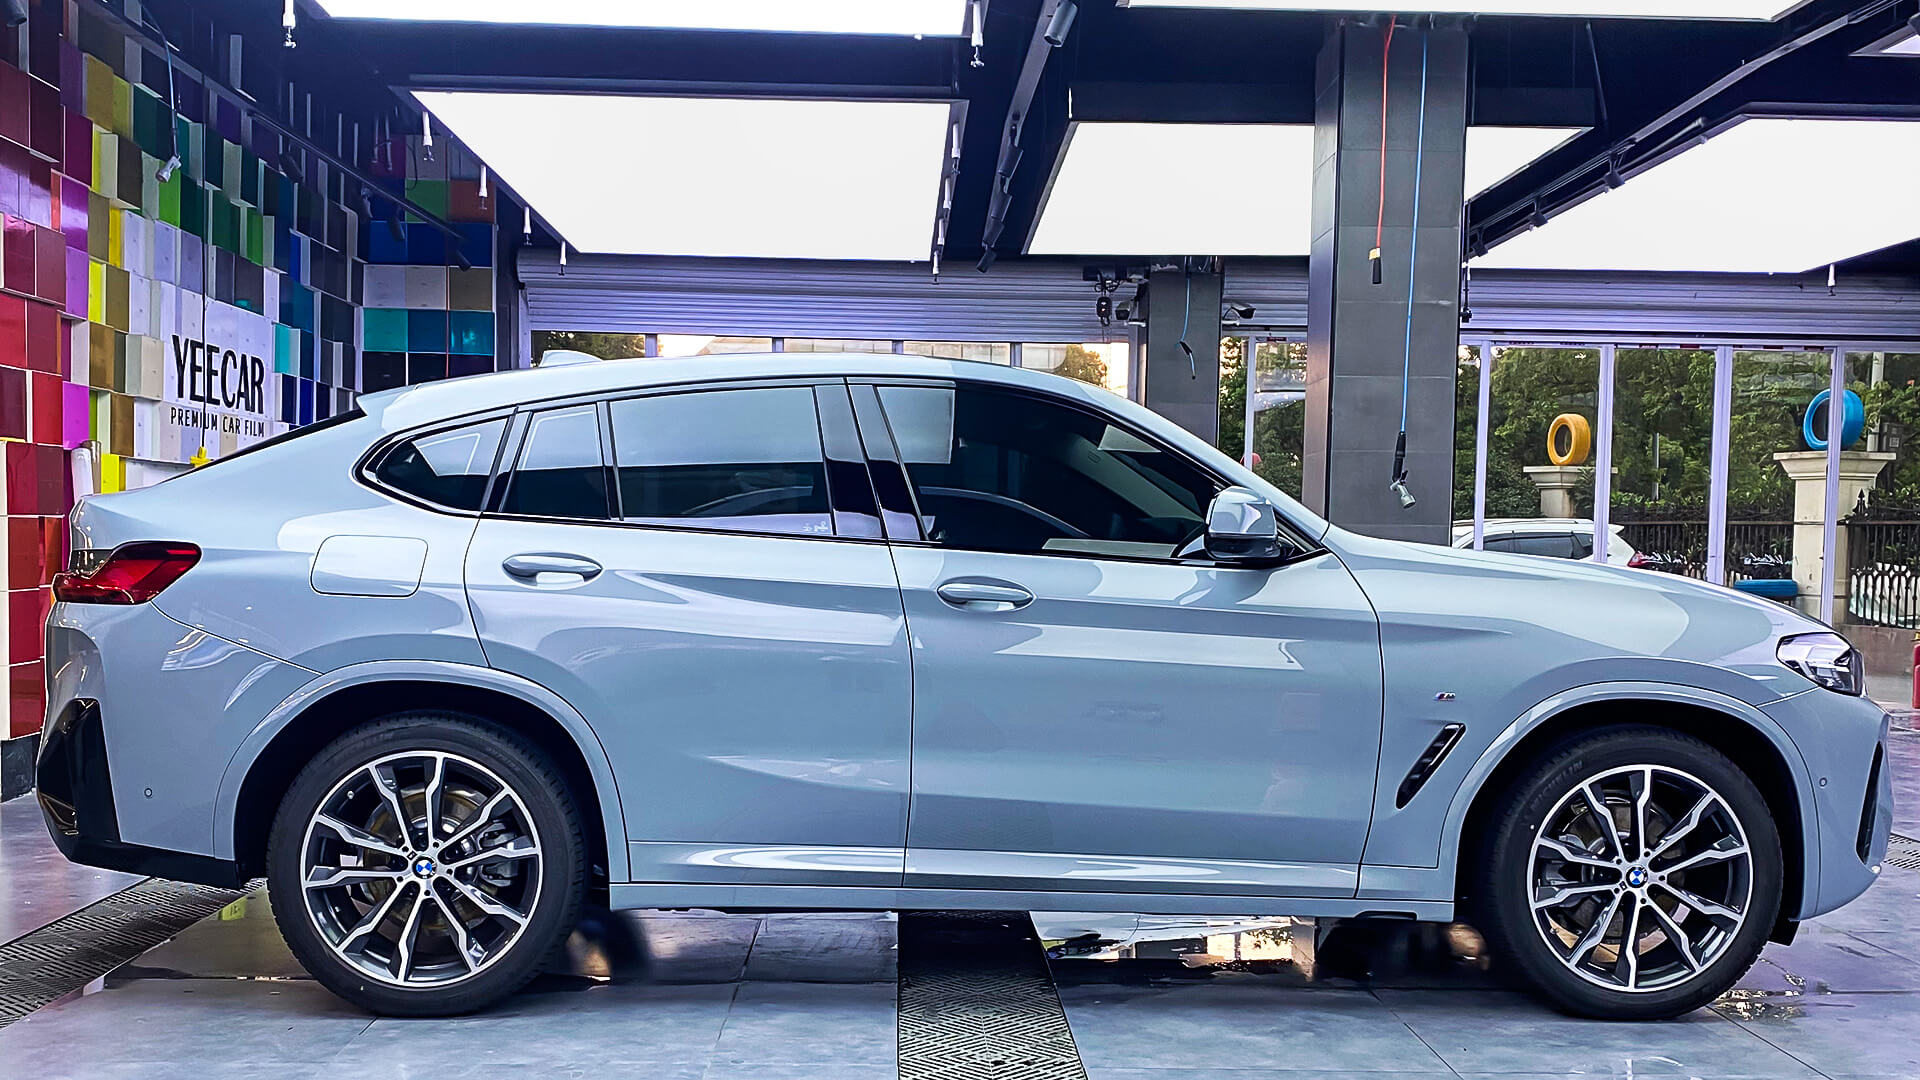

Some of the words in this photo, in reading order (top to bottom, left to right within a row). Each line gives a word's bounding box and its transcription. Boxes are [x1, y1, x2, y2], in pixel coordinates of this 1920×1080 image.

[171, 334, 264, 414] YEECAR
[170, 407, 218, 431] PREMIUM
[222, 416, 241, 434] CAR
[244, 420, 265, 437] FILM
